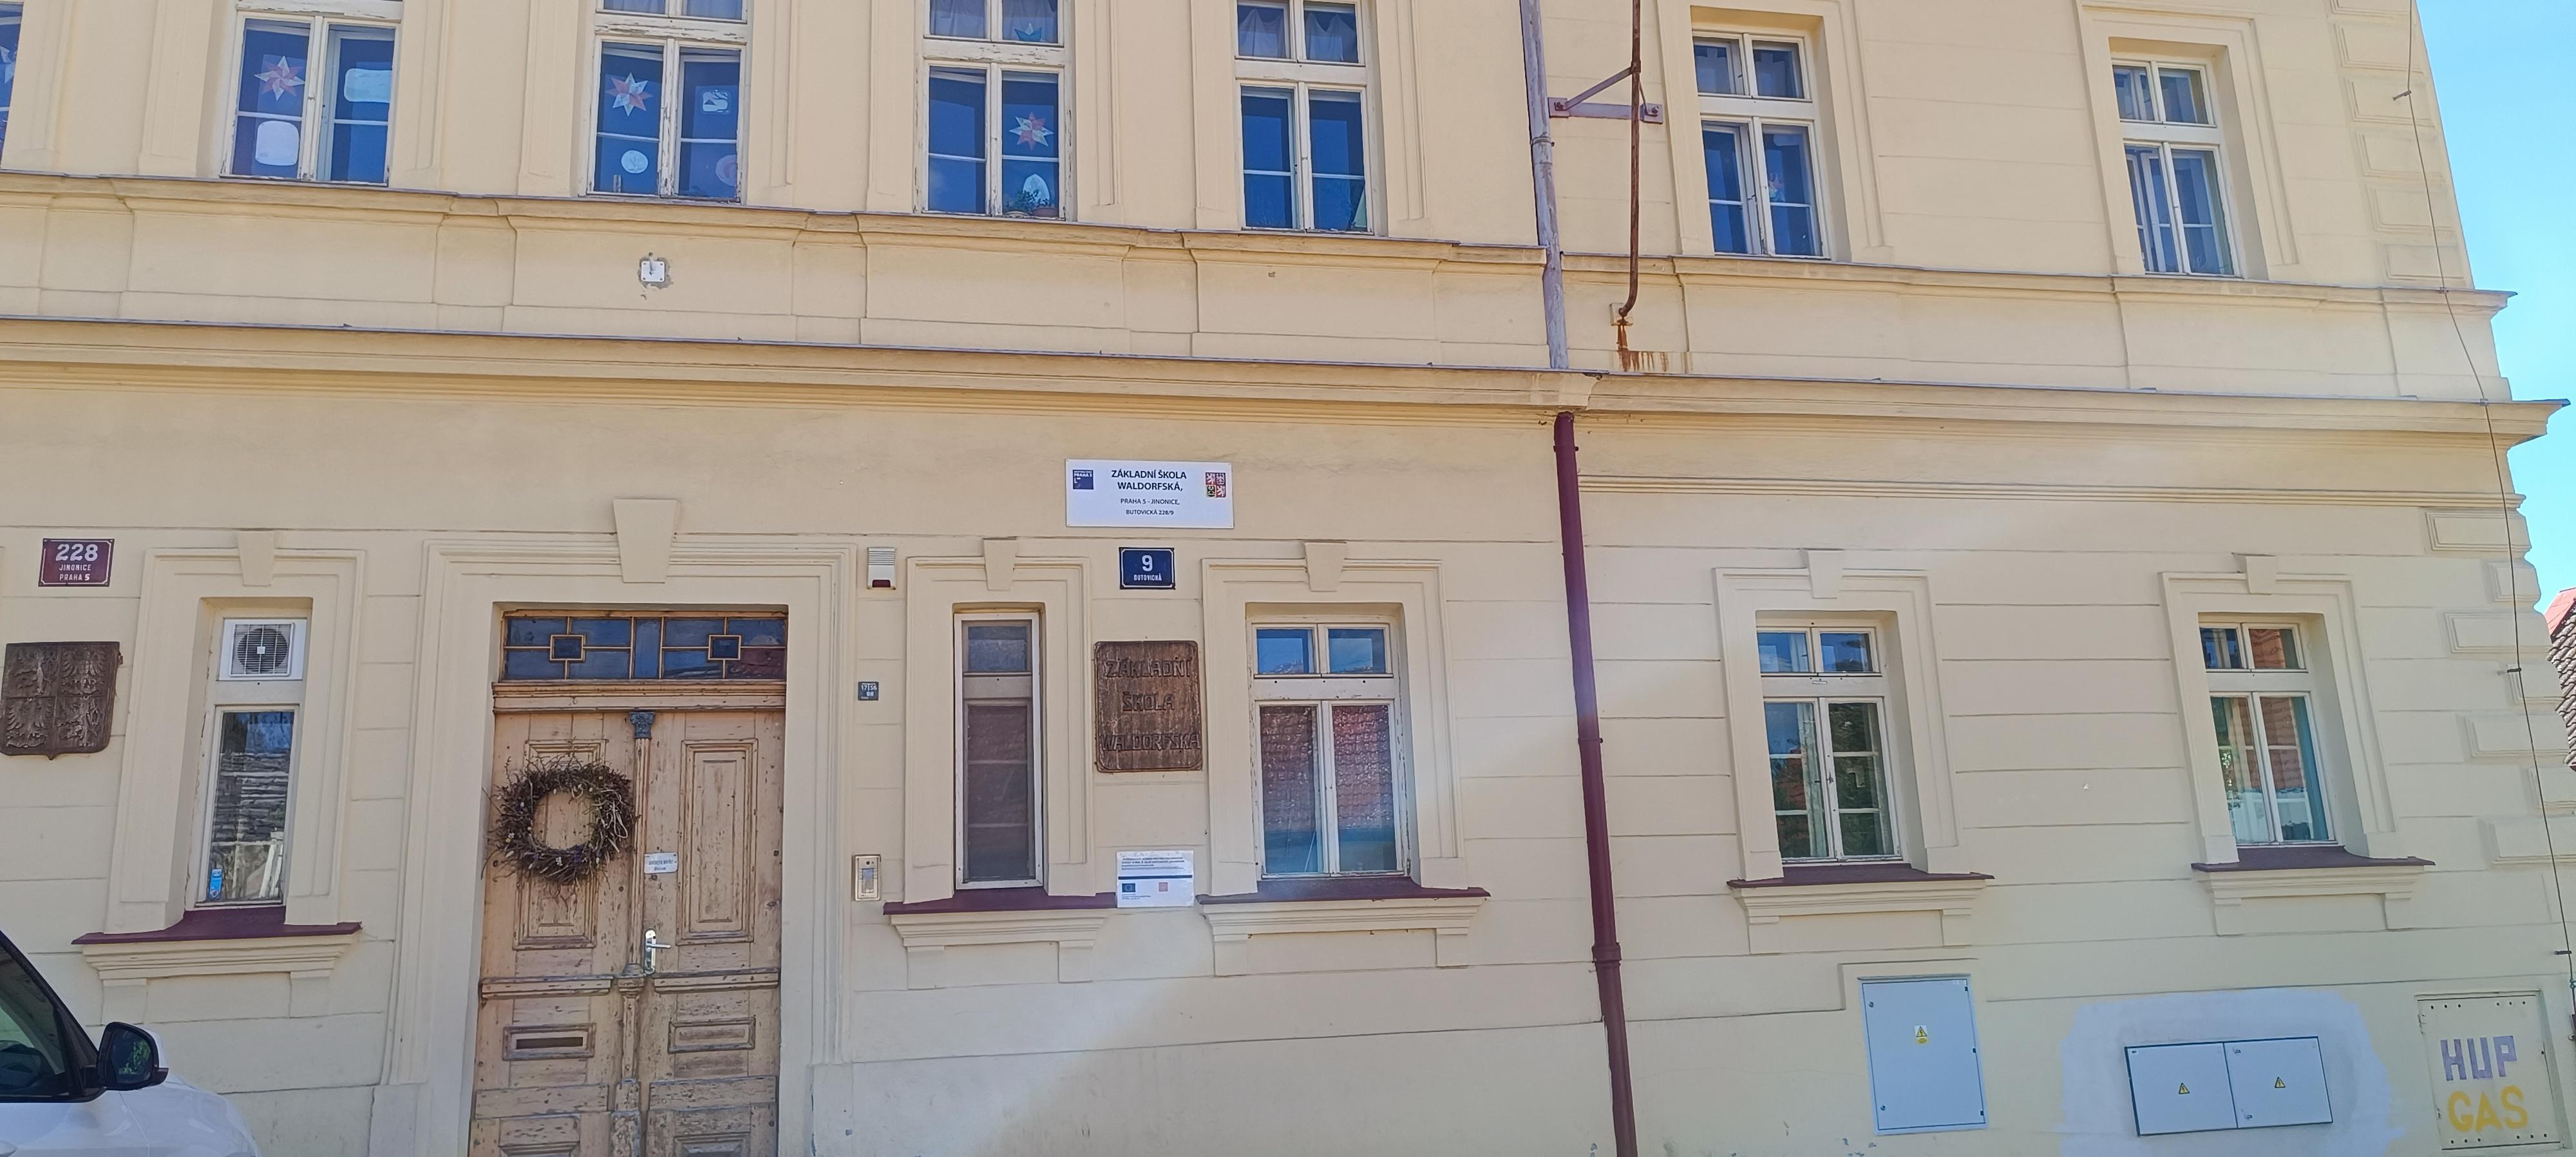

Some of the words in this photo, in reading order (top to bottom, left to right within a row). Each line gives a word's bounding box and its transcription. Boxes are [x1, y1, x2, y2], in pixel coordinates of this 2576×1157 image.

[1111, 470, 1157, 479] ZÁKLADNÍ
[1158, 470, 1187, 479] ŠKOLA
[1117, 481, 1183, 492] WALDORFSKÁ,
[55, 543, 98, 562] 228
[1142, 555, 1153, 571] 9
[1133, 573, 1162, 581] BUTOVICKÁ
[1122, 691, 1176, 712] ŠKOLA
[2440, 1035, 2517, 1082] HUP
[2447, 1084, 2530, 1133] GAS
